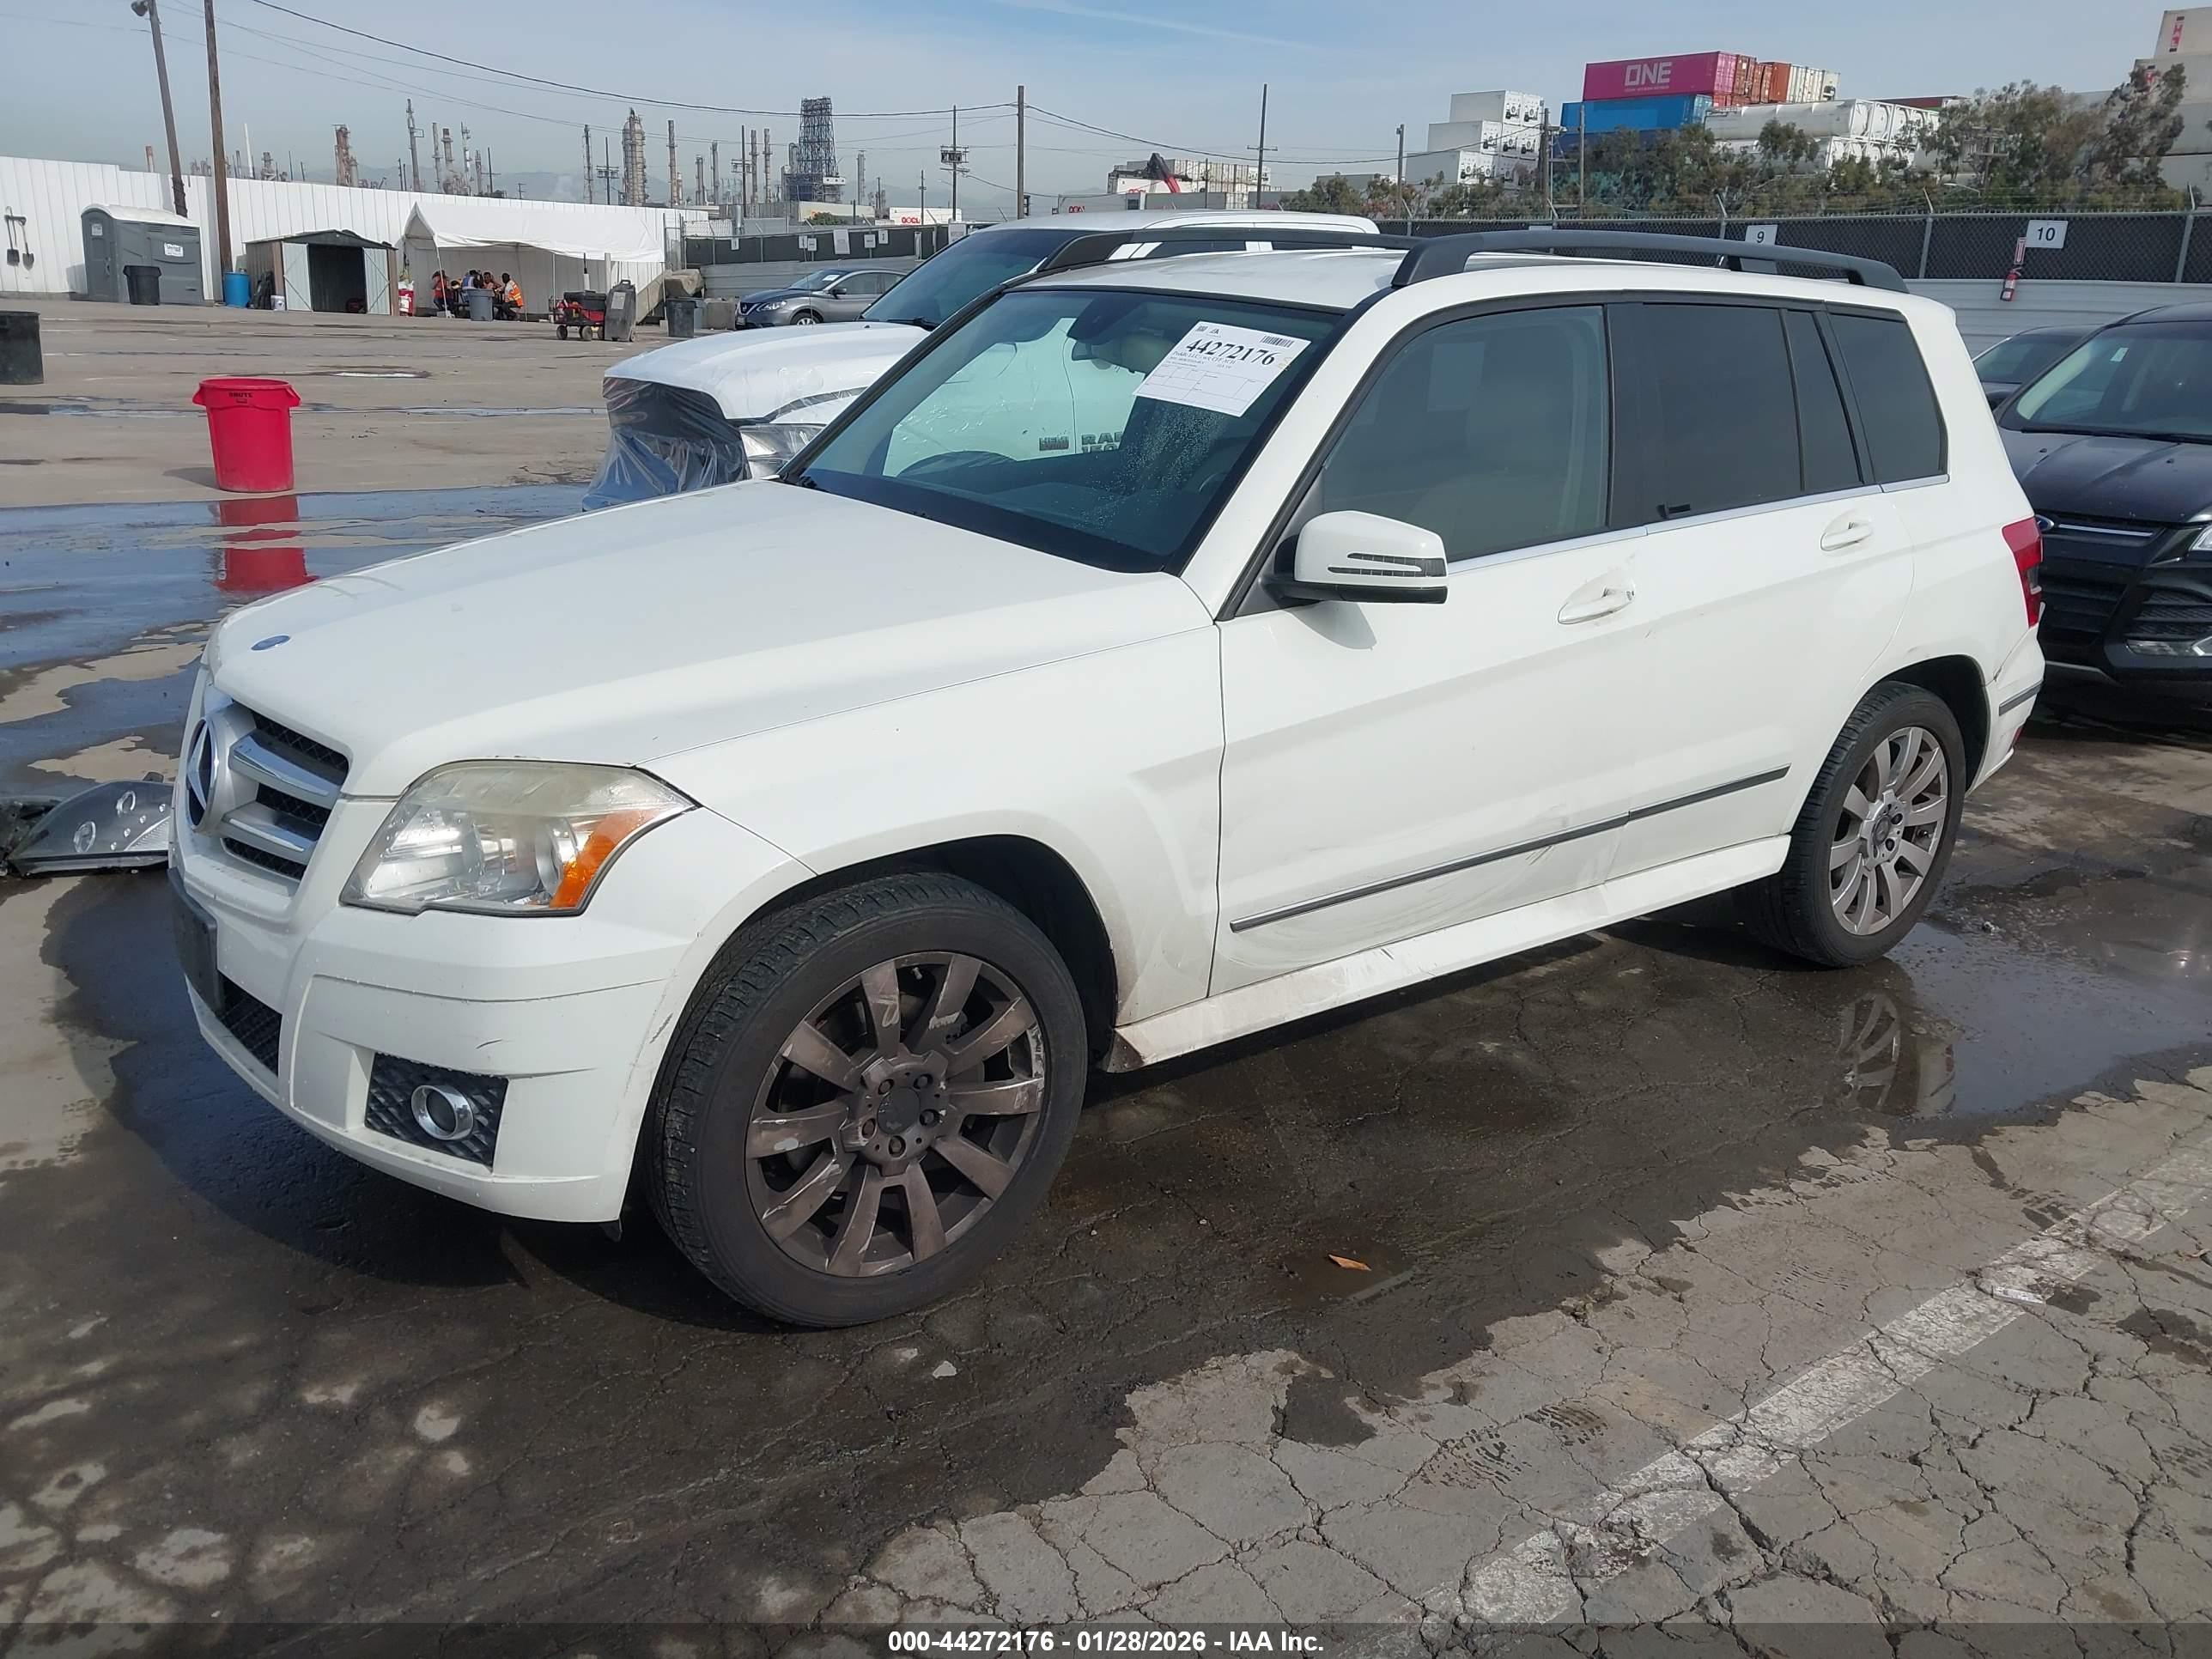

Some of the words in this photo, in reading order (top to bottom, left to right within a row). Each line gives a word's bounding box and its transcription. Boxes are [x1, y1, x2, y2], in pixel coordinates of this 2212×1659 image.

[1624, 61, 1673, 87] ONE
[1756, 231, 1765, 243] 9
[2037, 227, 2056, 241] 10
[1186, 338, 1283, 366] 44272176
